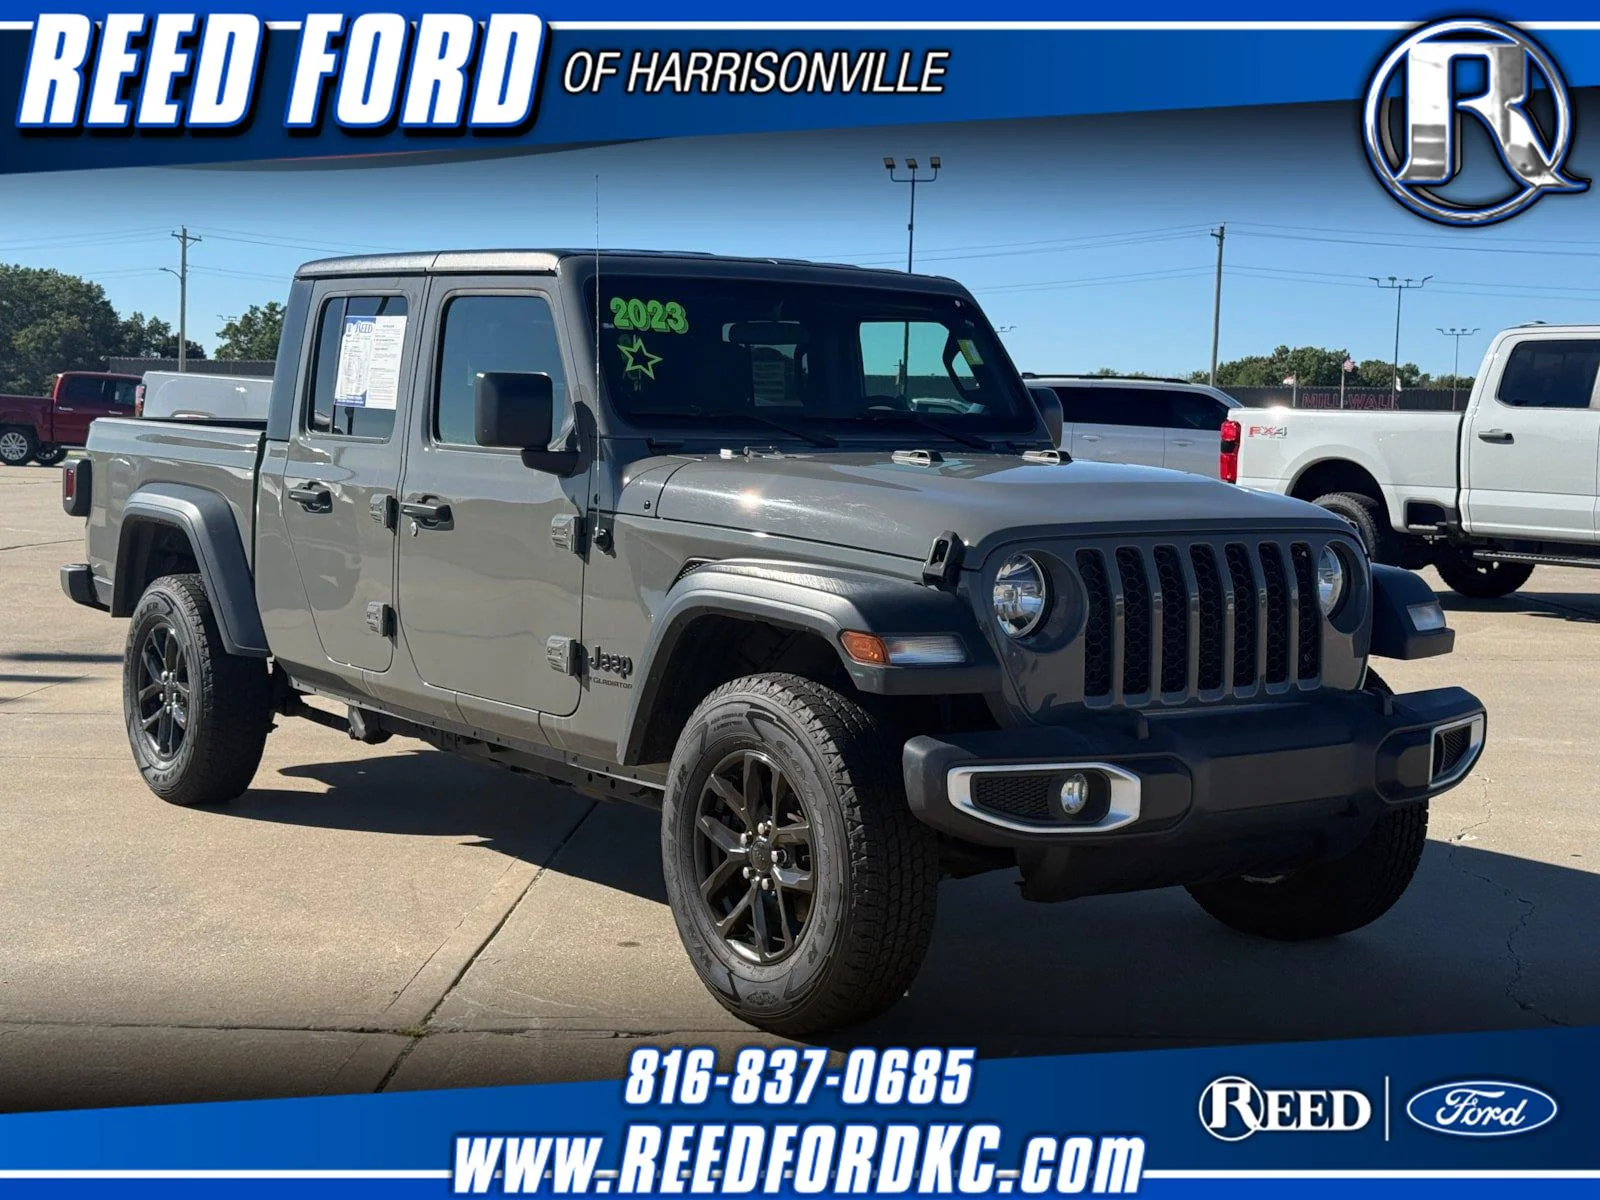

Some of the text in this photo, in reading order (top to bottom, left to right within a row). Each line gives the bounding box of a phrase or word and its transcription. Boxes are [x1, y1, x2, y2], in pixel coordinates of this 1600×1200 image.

[609, 297, 689, 334] 2023
[1249, 425, 1288, 437] FX4
[588, 645, 633, 679] Jeep
[592, 676, 633, 689] GLADIATOR
